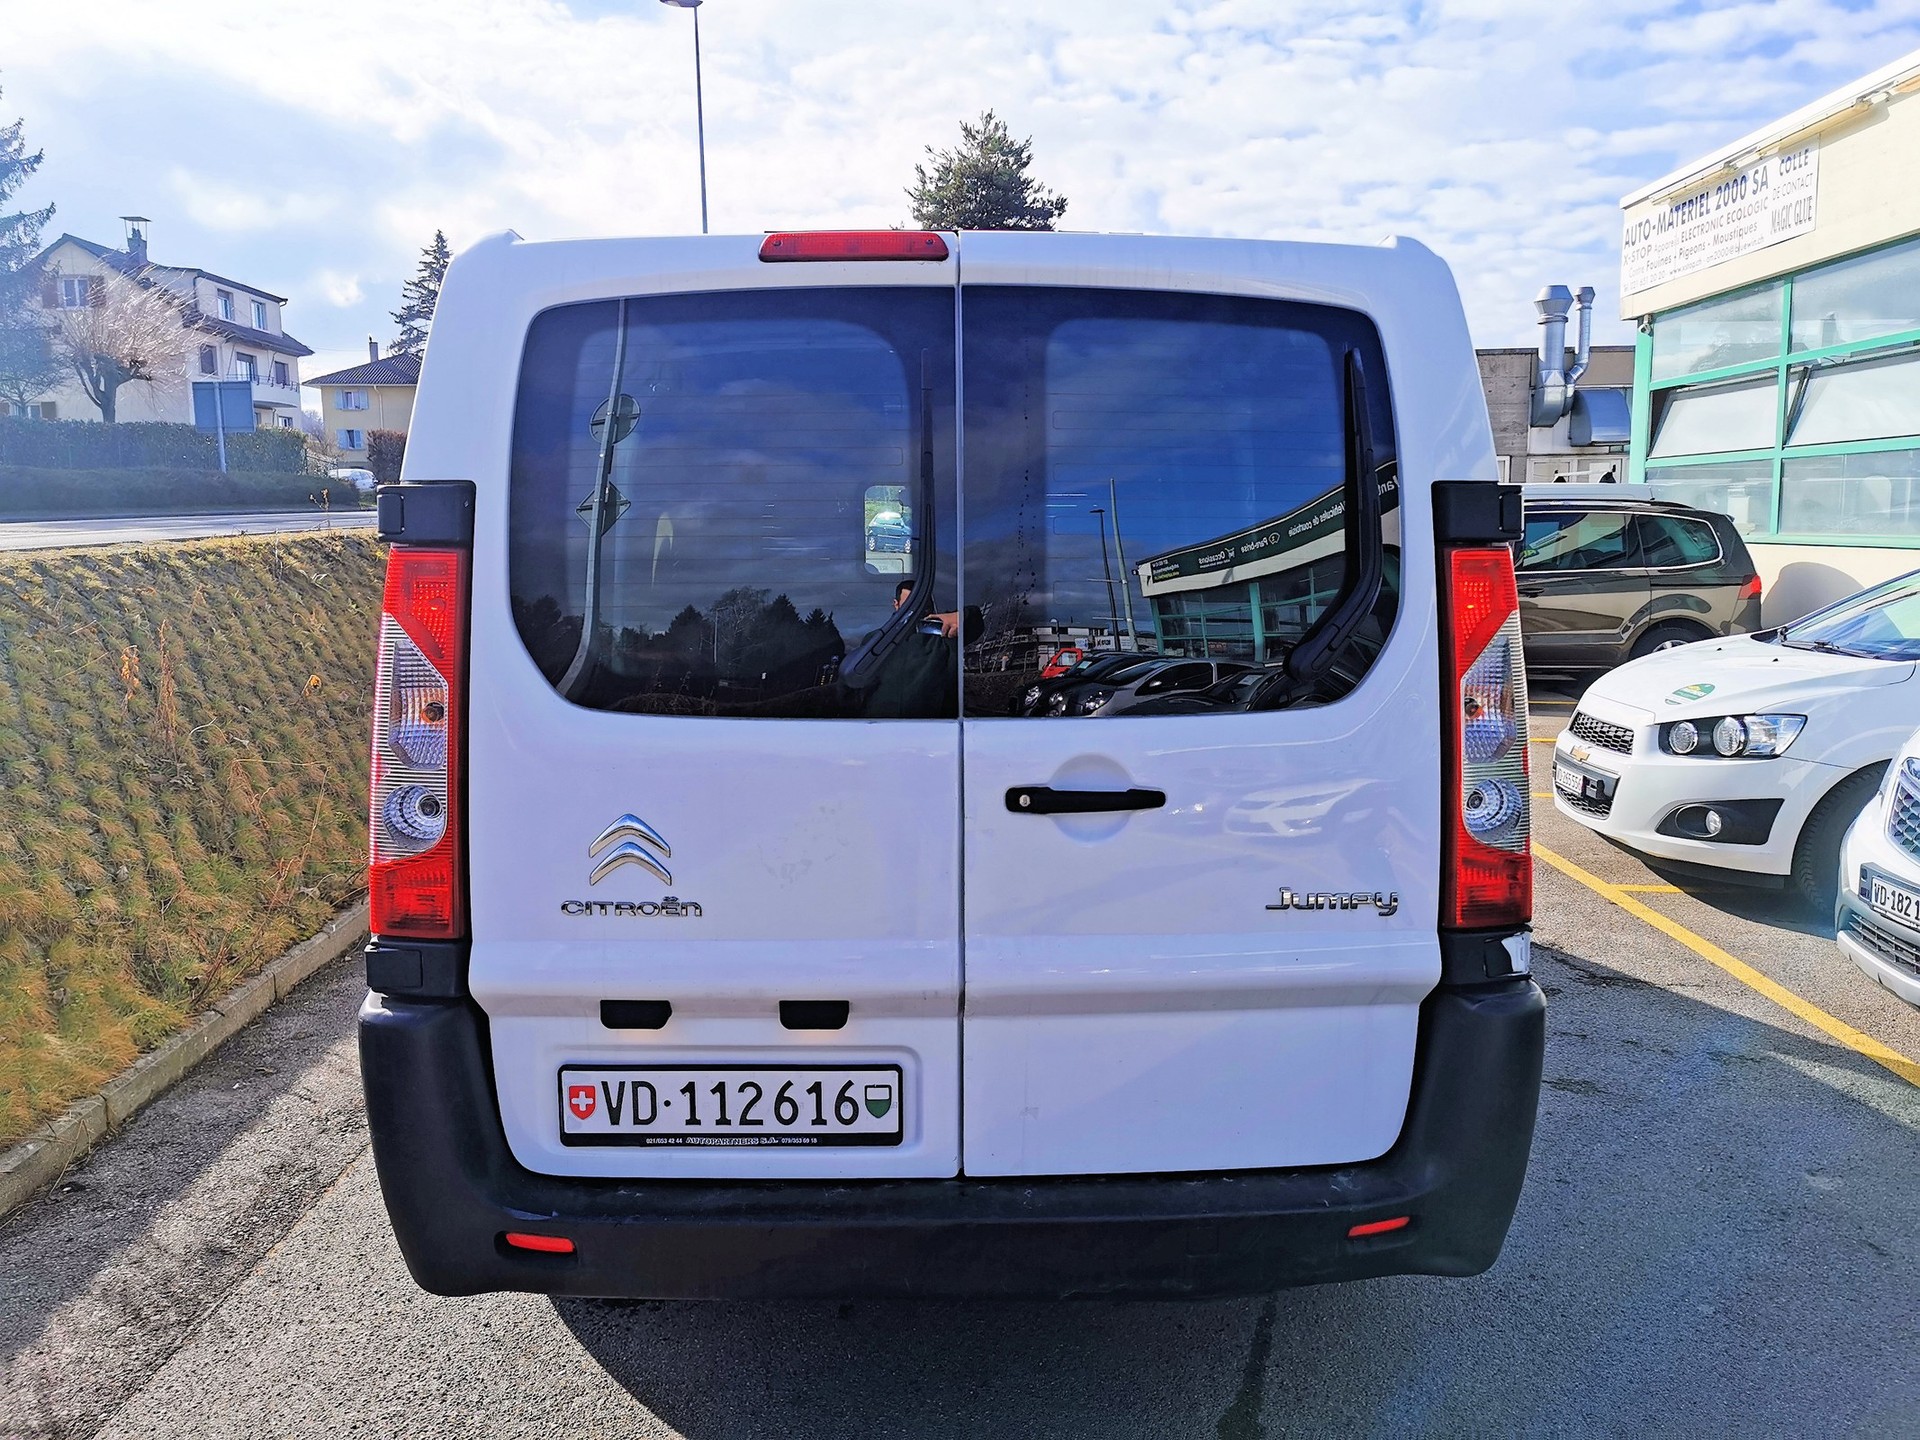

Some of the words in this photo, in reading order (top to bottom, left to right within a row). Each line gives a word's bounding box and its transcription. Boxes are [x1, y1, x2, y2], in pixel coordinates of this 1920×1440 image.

[1779, 148, 1810, 177] COLLE
[1772, 186, 1781, 201] DE
[1782, 172, 1814, 197] CONTACT
[1624, 192, 1711, 249] AUTO-MATERIEL
[1715, 174, 1748, 211] 2000
[1752, 165, 1769, 196] SA
[1770, 202, 1793, 235] MAGIC
[1793, 195, 1813, 227] GLUE
[1623, 244, 1653, 266] X-STOP
[1681, 215, 1724, 244] ELECTRONIC
[1726, 196, 1769, 225] ECOLOGIC
[1646, 254, 1672, 272] Fouines
[1678, 239, 1706, 261] Pigeons
[1712, 220, 1758, 247] Moustiques
[1265, 886, 1400, 917] Jumpy
[685, 1136, 759, 1146] AUTOPARTNERS
